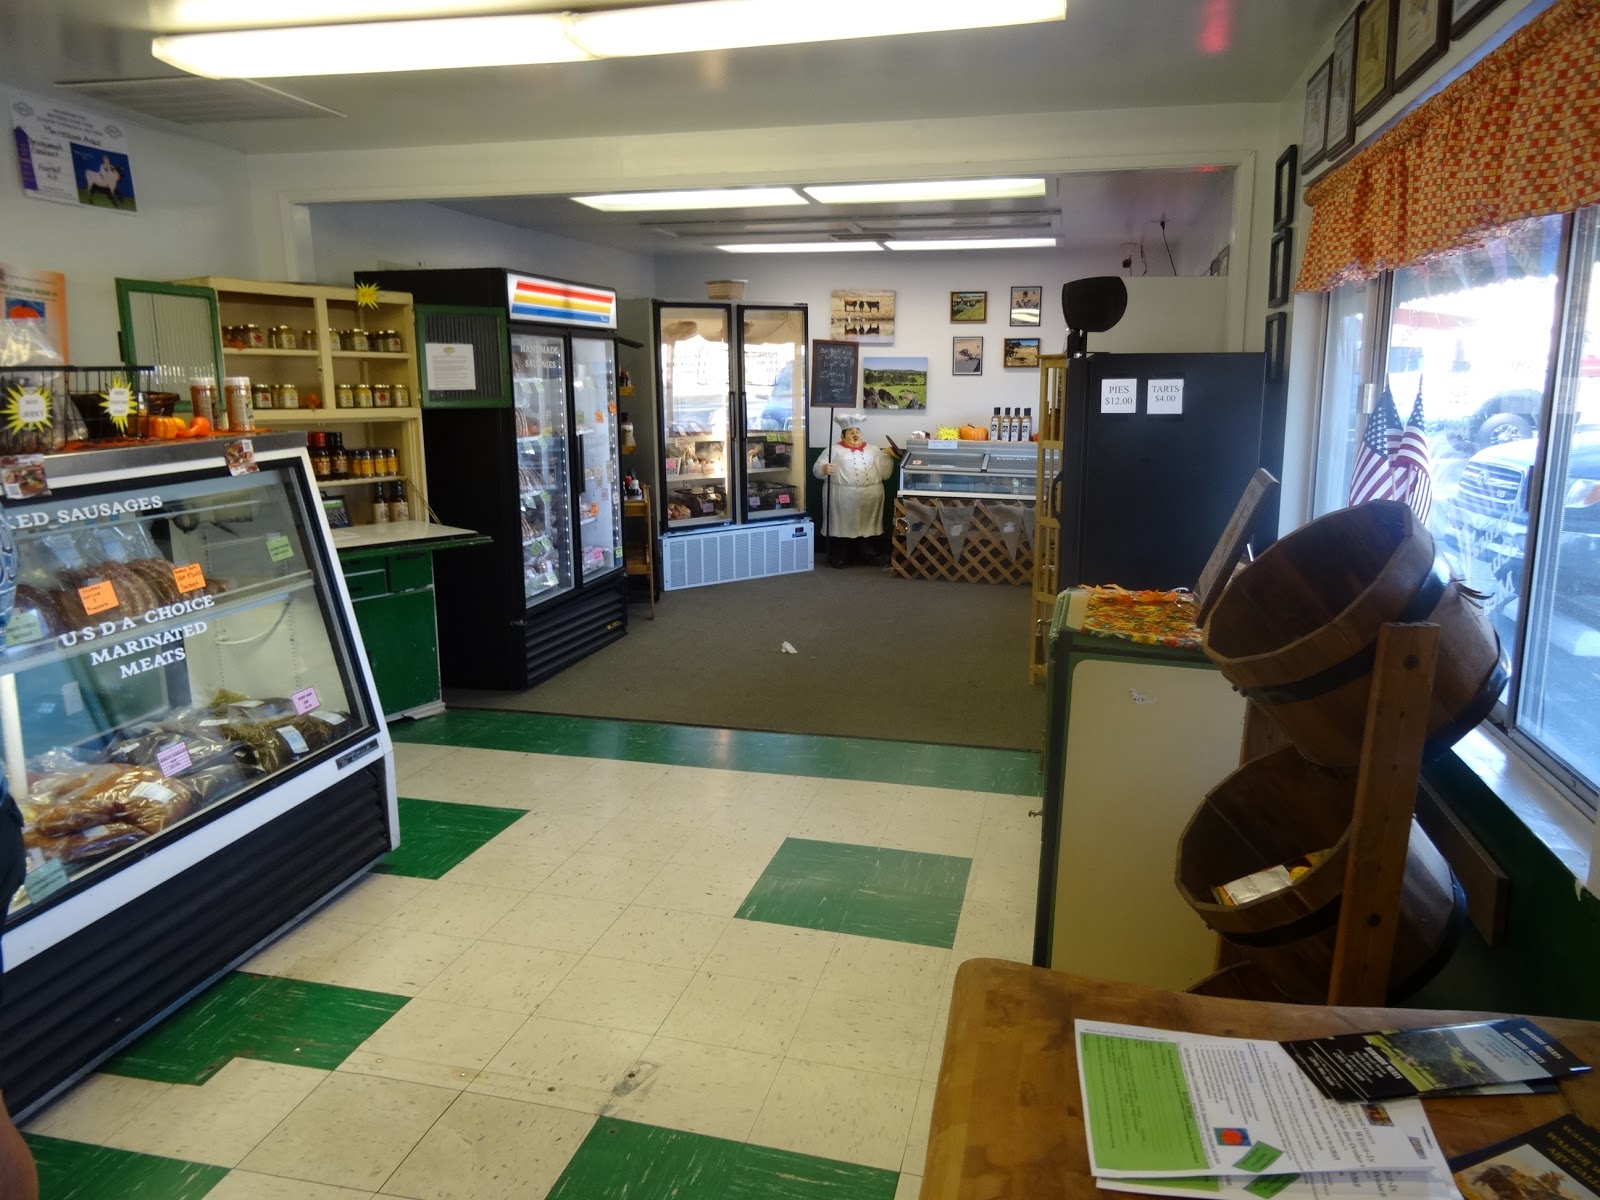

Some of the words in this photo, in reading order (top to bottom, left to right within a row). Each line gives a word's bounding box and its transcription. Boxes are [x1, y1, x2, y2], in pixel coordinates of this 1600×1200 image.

[520, 345, 560, 354] HANDMADE
[524, 360, 557, 369] SAUSAGES
[1109, 385, 1130, 394] PIES
[1151, 385, 1180, 393] TARTS
[1105, 397, 1133, 405] $12.00
[1155, 395, 1176, 403] $4.00
[57, 495, 163, 524] SAUSAGES
[144, 594, 215, 623] CHOICE
[90, 621, 208, 666] MARINATED
[119, 647, 187, 679] MEATS
